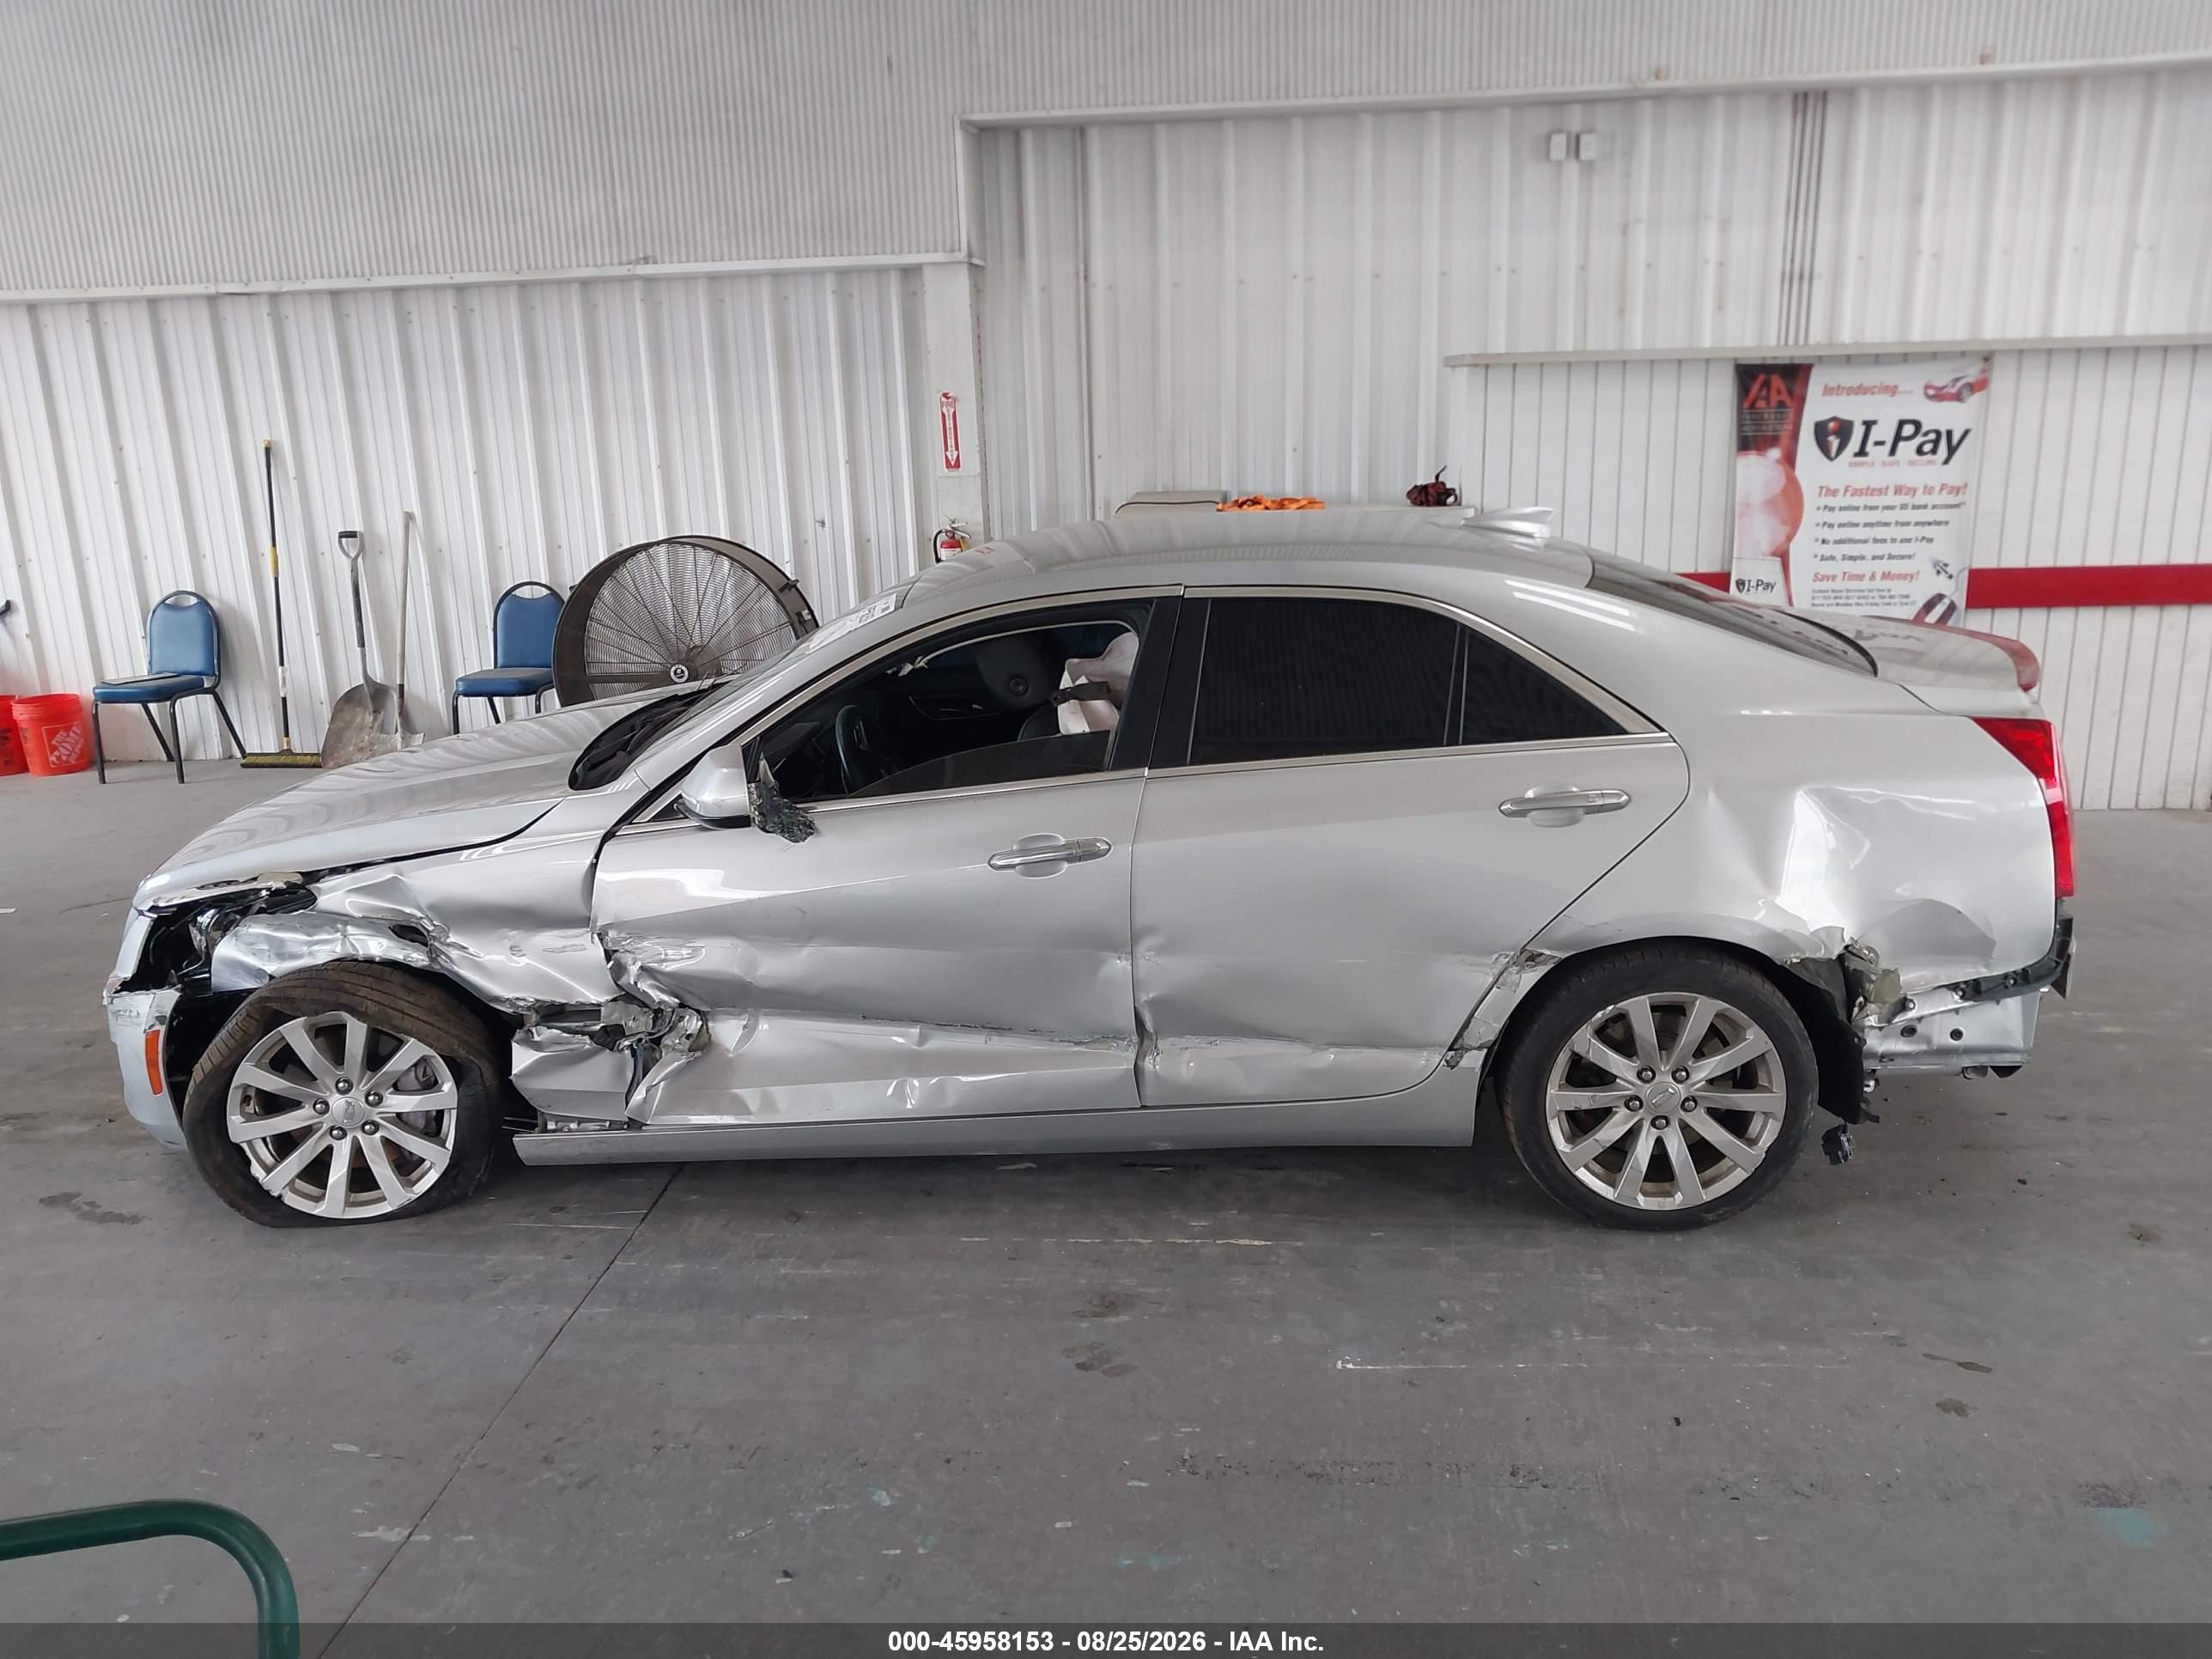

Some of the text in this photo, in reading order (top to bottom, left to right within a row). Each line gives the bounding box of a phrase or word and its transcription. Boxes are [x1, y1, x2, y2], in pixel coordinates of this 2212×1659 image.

[1853, 418, 1972, 465] I-Pay
[1818, 482, 1968, 498] The Fastest Way to Pay!
[1822, 504, 1836, 514] Pay
[1821, 521, 1835, 530] Pay
[1812, 570, 1920, 583] Save Time & Money!
[1746, 579, 1777, 593] I-Pay
